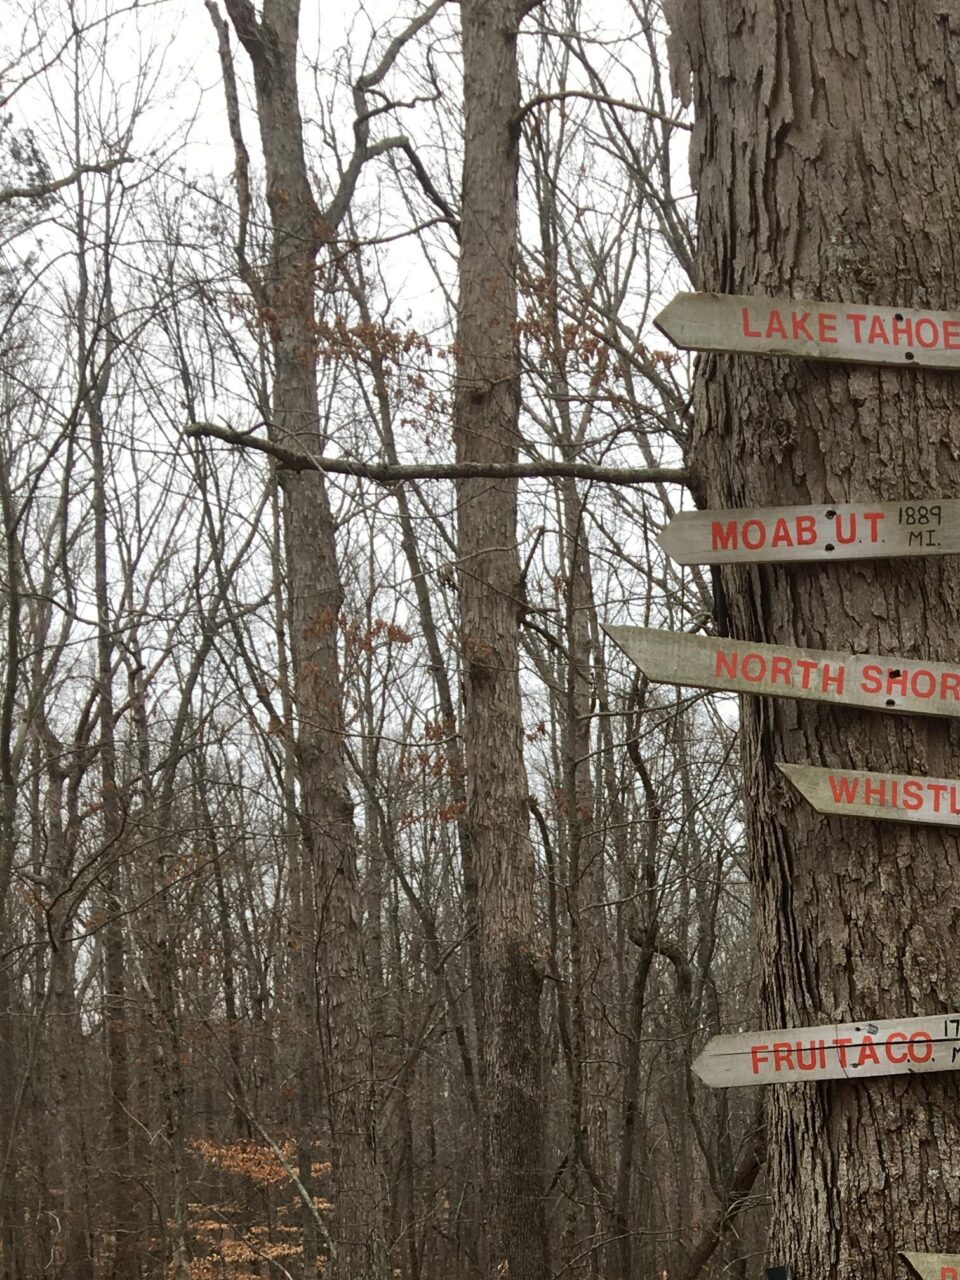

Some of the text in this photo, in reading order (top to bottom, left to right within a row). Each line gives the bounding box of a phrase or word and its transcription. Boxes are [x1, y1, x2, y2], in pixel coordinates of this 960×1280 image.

[742, 307, 838, 344] LAKE
[711, 516, 818, 551] MOAB
[898, 506, 942, 526] 1889
[715, 649, 845, 695] NORTH
[751, 1034, 881, 1075] FRUITA
